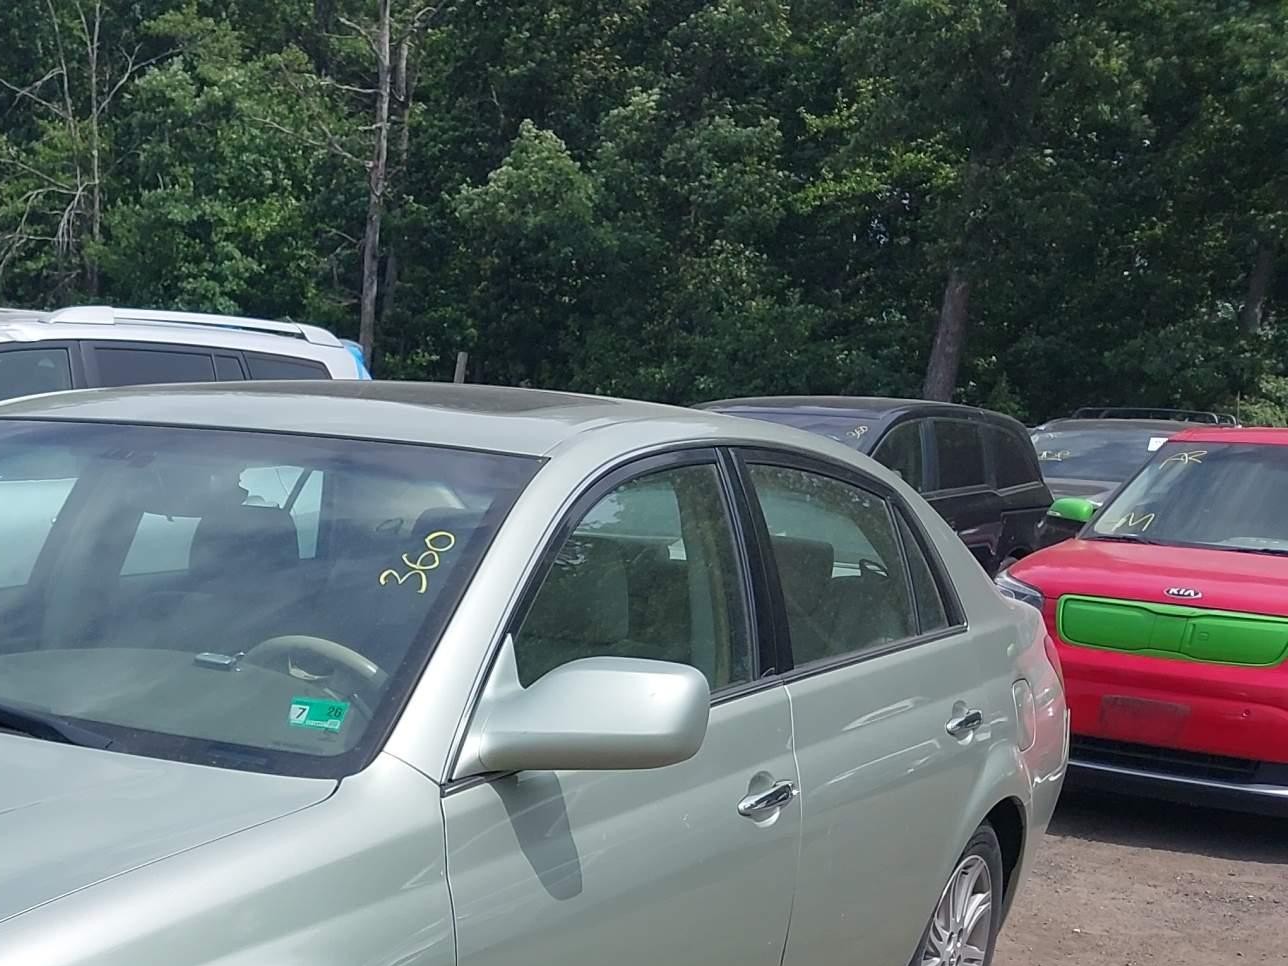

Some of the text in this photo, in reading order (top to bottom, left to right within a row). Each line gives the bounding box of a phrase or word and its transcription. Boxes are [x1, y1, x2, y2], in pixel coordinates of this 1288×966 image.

[379, 531, 455, 593] 360
[1168, 587, 1195, 597] KIA
[296, 707, 307, 719] 7
